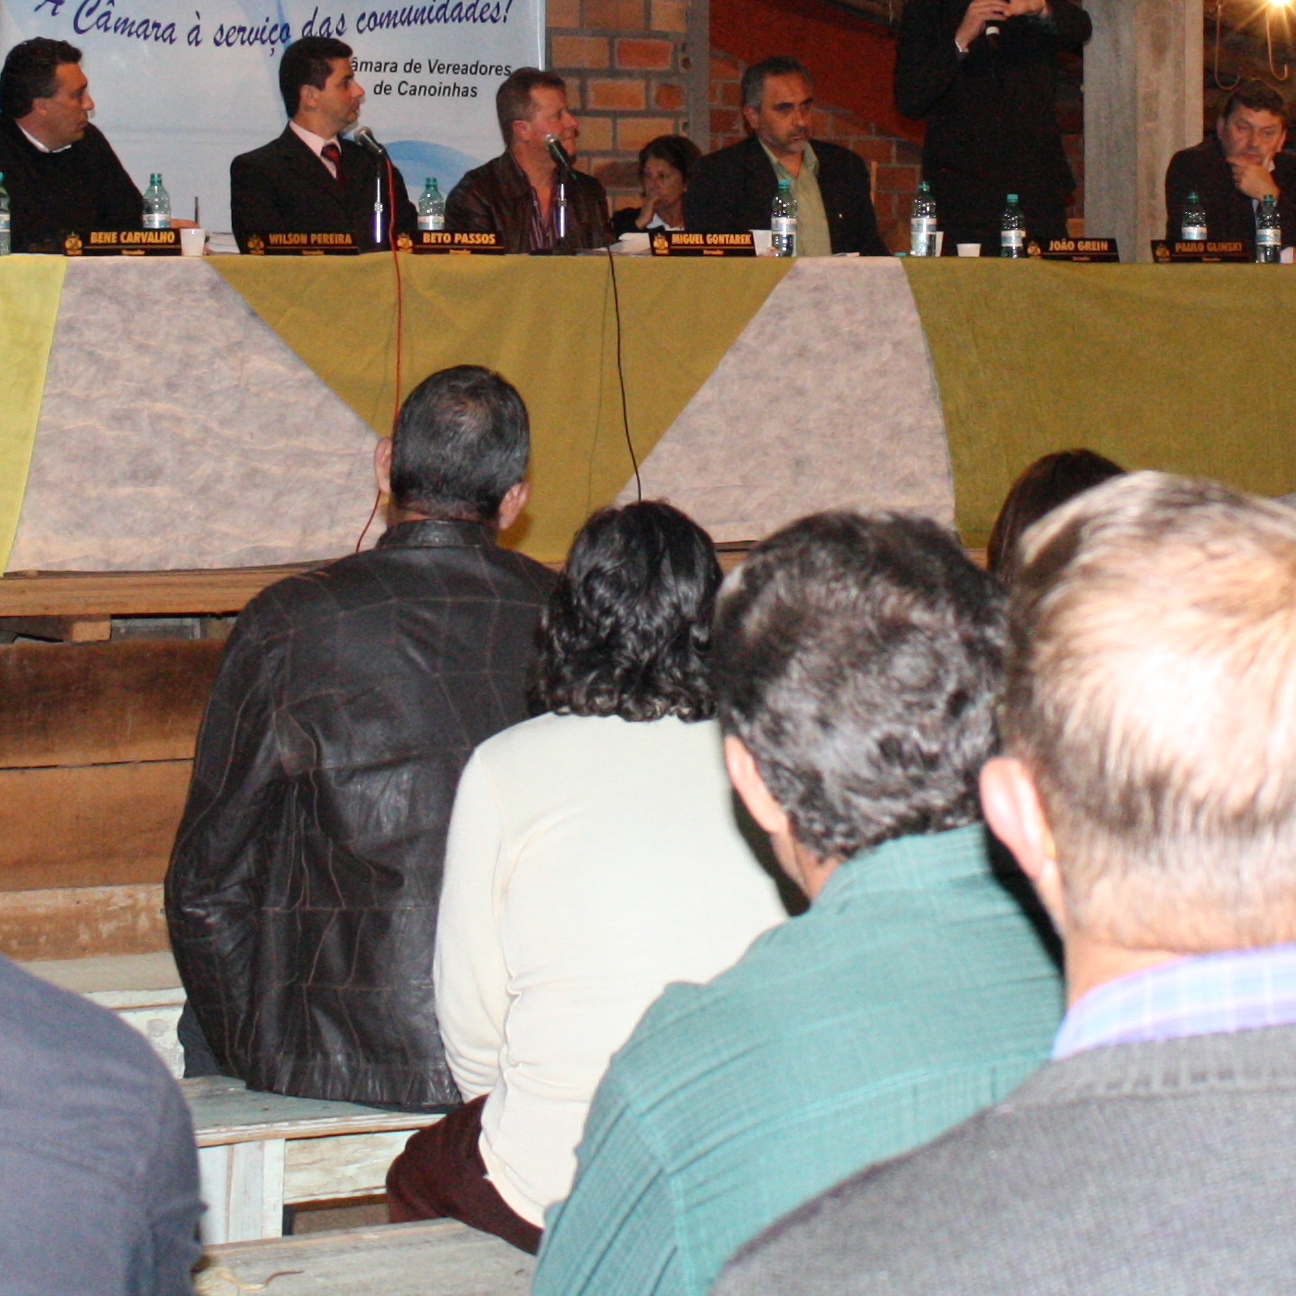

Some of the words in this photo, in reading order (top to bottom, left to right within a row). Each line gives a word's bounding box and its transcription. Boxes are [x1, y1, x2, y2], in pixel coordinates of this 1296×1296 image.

[187, 11, 203, 47] à
[213, 16, 292, 57] serviço
[301, 6, 347, 38] das
[351, 57, 398, 73] âmara
[403, 58, 422, 74] de
[428, 59, 512, 76] Vereadores
[373, 80, 392, 95] de
[398, 81, 478, 97] Canoinhas
[119, 231, 175, 244] CARVALHO
[269, 233, 307, 244] WILSON
[310, 233, 352, 244] PEREIRA
[423, 232, 452, 244] BETO
[454, 233, 496, 244] PASSOS
[671, 233, 704, 244] MIGUEL
[1049, 239, 1075, 251] JOÃO
[1175, 242, 1204, 253] PAULO
